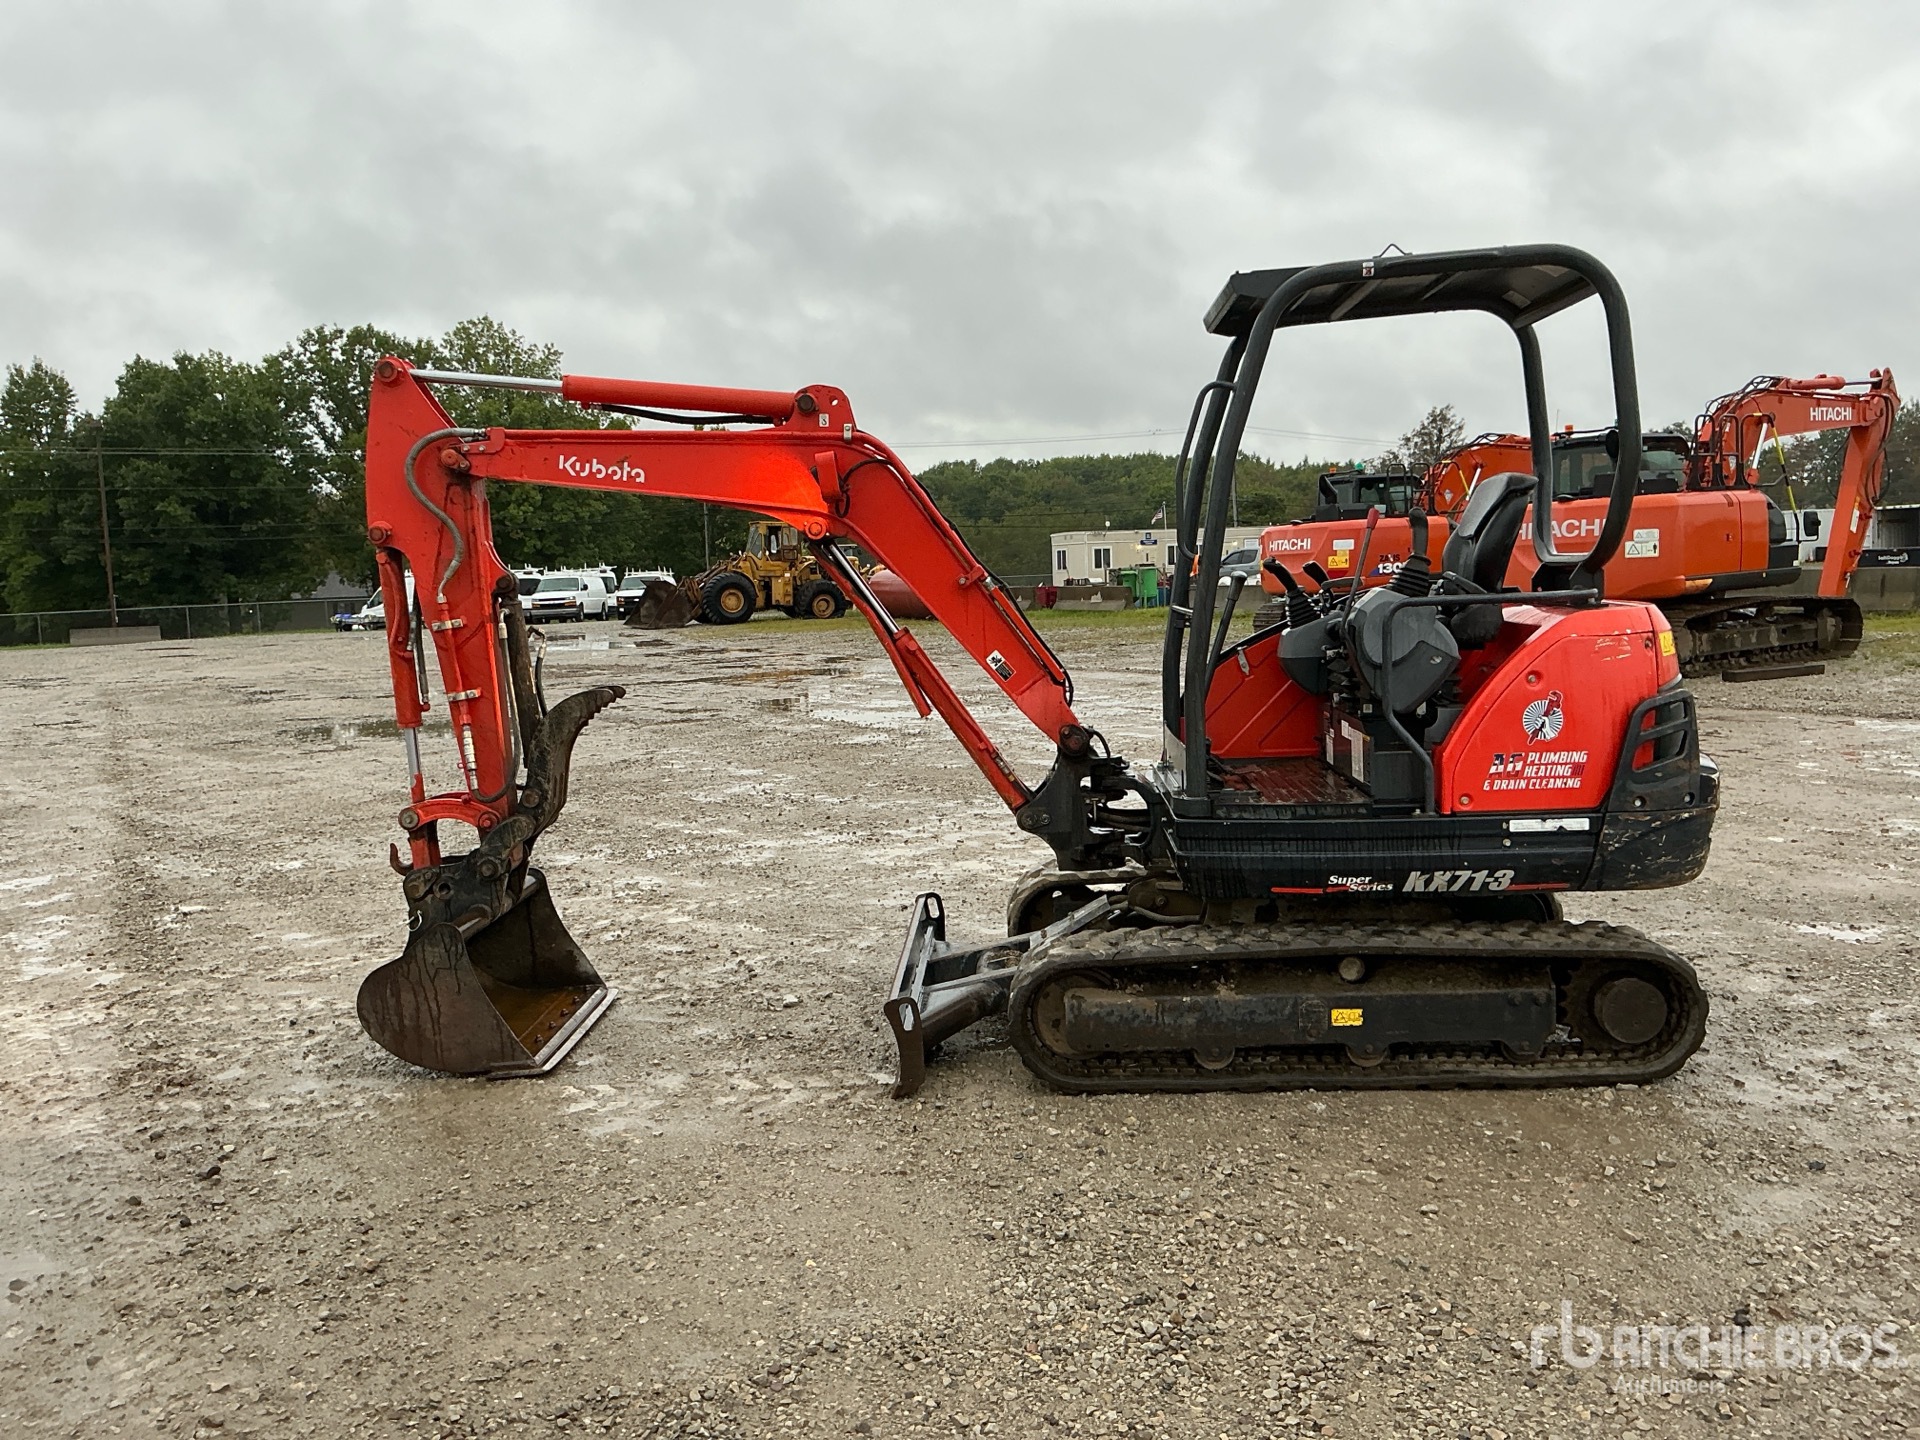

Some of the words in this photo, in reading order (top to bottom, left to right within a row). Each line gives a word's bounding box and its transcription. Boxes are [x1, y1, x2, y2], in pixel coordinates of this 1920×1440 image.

[1810, 406, 1852, 421] HITACHI
[558, 454, 645, 483] Kubota
[1519, 518, 1606, 541] IACH
[1269, 538, 1311, 552] HITACHI
[1488, 753, 1525, 778] AG
[1526, 751, 1589, 764] PLUMBING
[1523, 764, 1573, 777] HEATING
[1483, 780, 1491, 791] &
[1493, 779, 1527, 790] DRAIN
[1529, 777, 1582, 789] CLEANING
[1328, 875, 1372, 888] Super
[1349, 882, 1394, 892] Series
[1402, 869, 1515, 893] KX71-3
